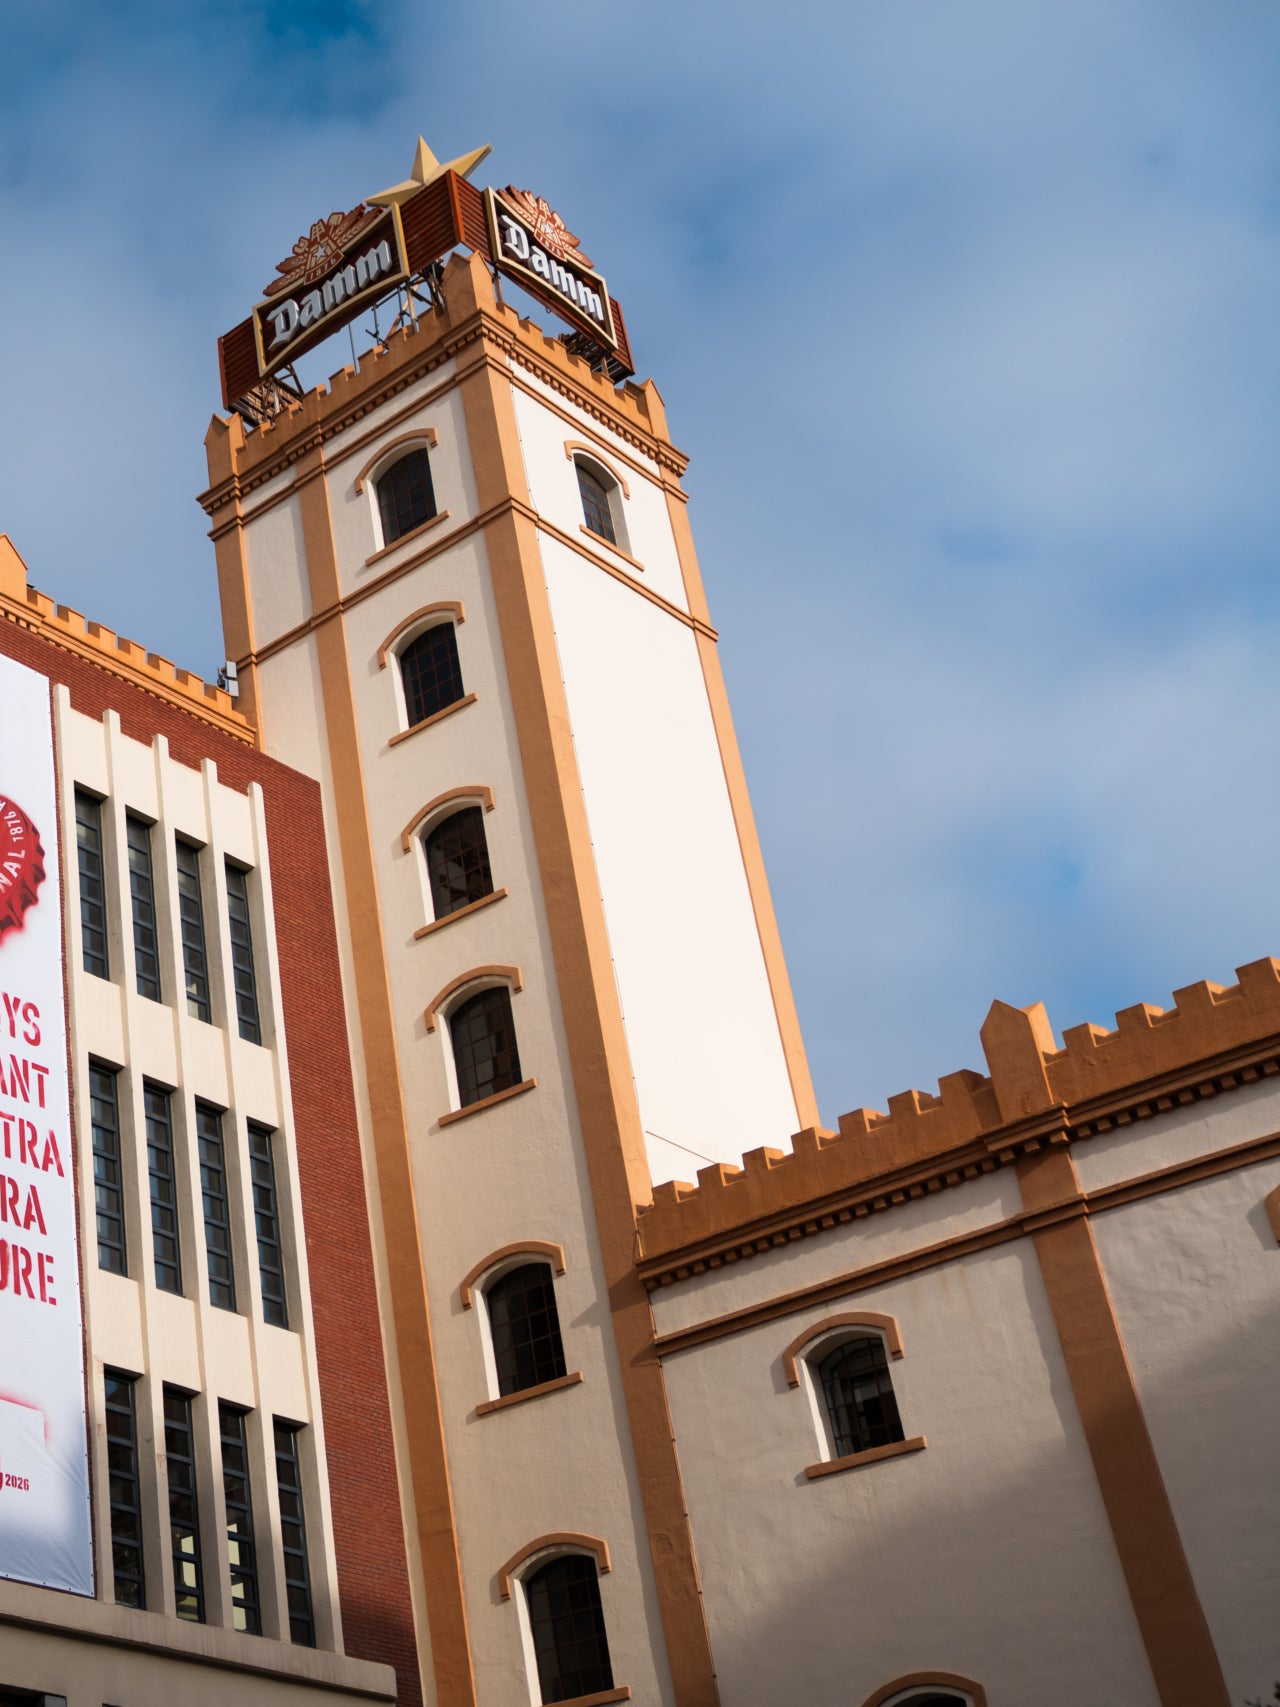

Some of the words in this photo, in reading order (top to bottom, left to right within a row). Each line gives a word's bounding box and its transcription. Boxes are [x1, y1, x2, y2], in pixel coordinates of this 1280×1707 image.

[266, 239, 392, 350] Damm
[501, 214, 604, 320] Damm
[3, 811, 24, 843] 1876
[5, 1474, 29, 1491] 2026
